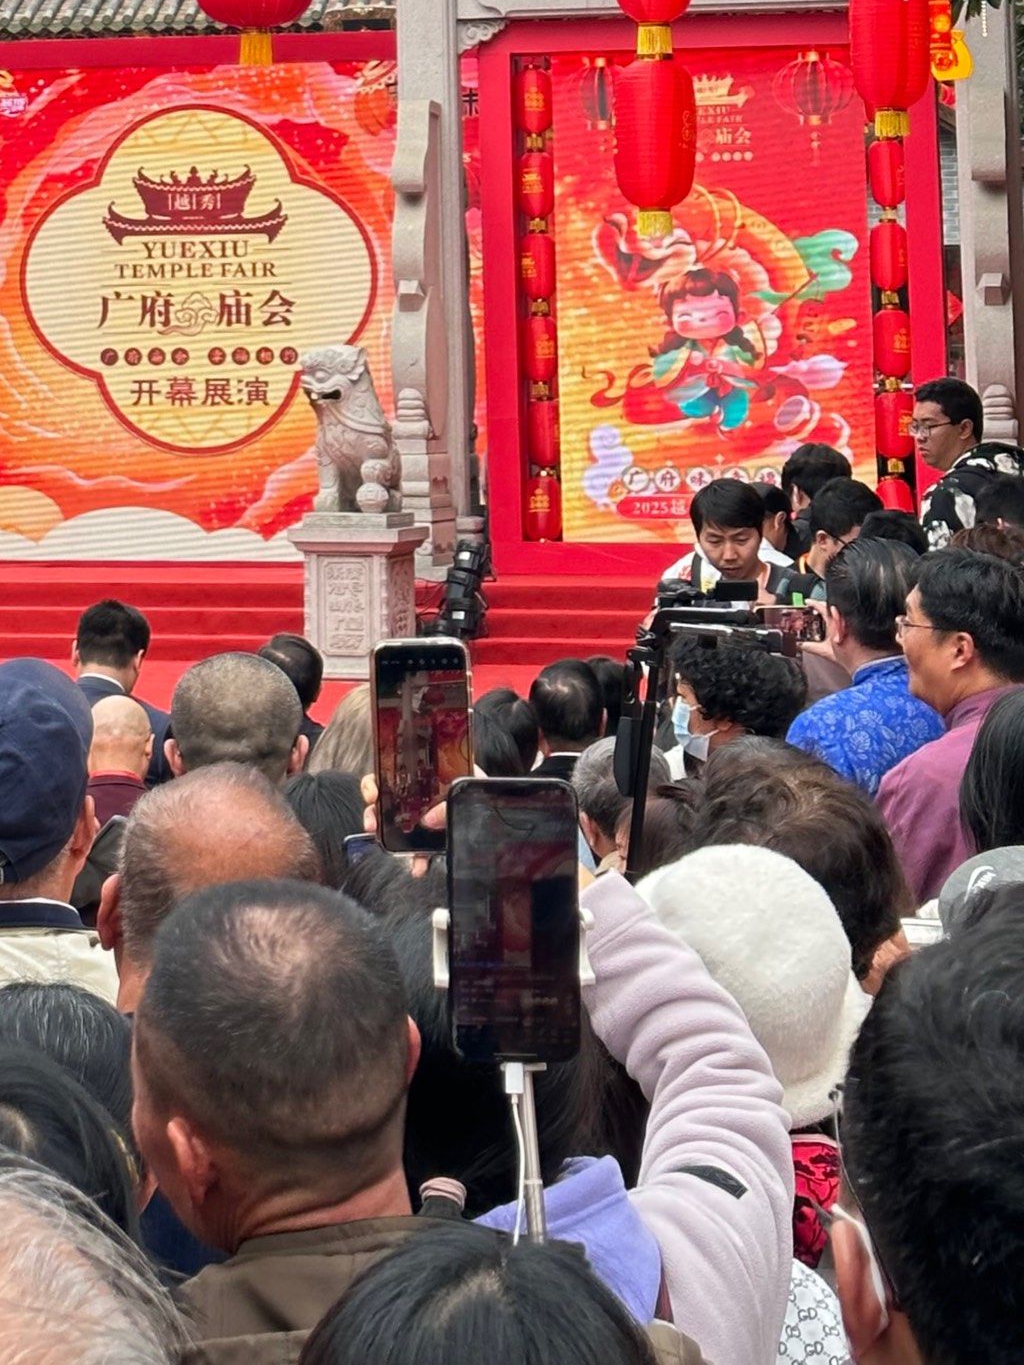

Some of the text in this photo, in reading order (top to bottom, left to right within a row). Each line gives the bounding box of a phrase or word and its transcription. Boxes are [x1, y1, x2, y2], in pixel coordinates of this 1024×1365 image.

[716, 126, 751, 145] 庙会
[174, 192, 216, 211] 越秀
[142, 240, 249, 259] YUEXIU
[114, 262, 277, 279] TEMPLE FAIR
[97, 288, 296, 329] 广府庙会
[130, 376, 270, 407] 开幕展演
